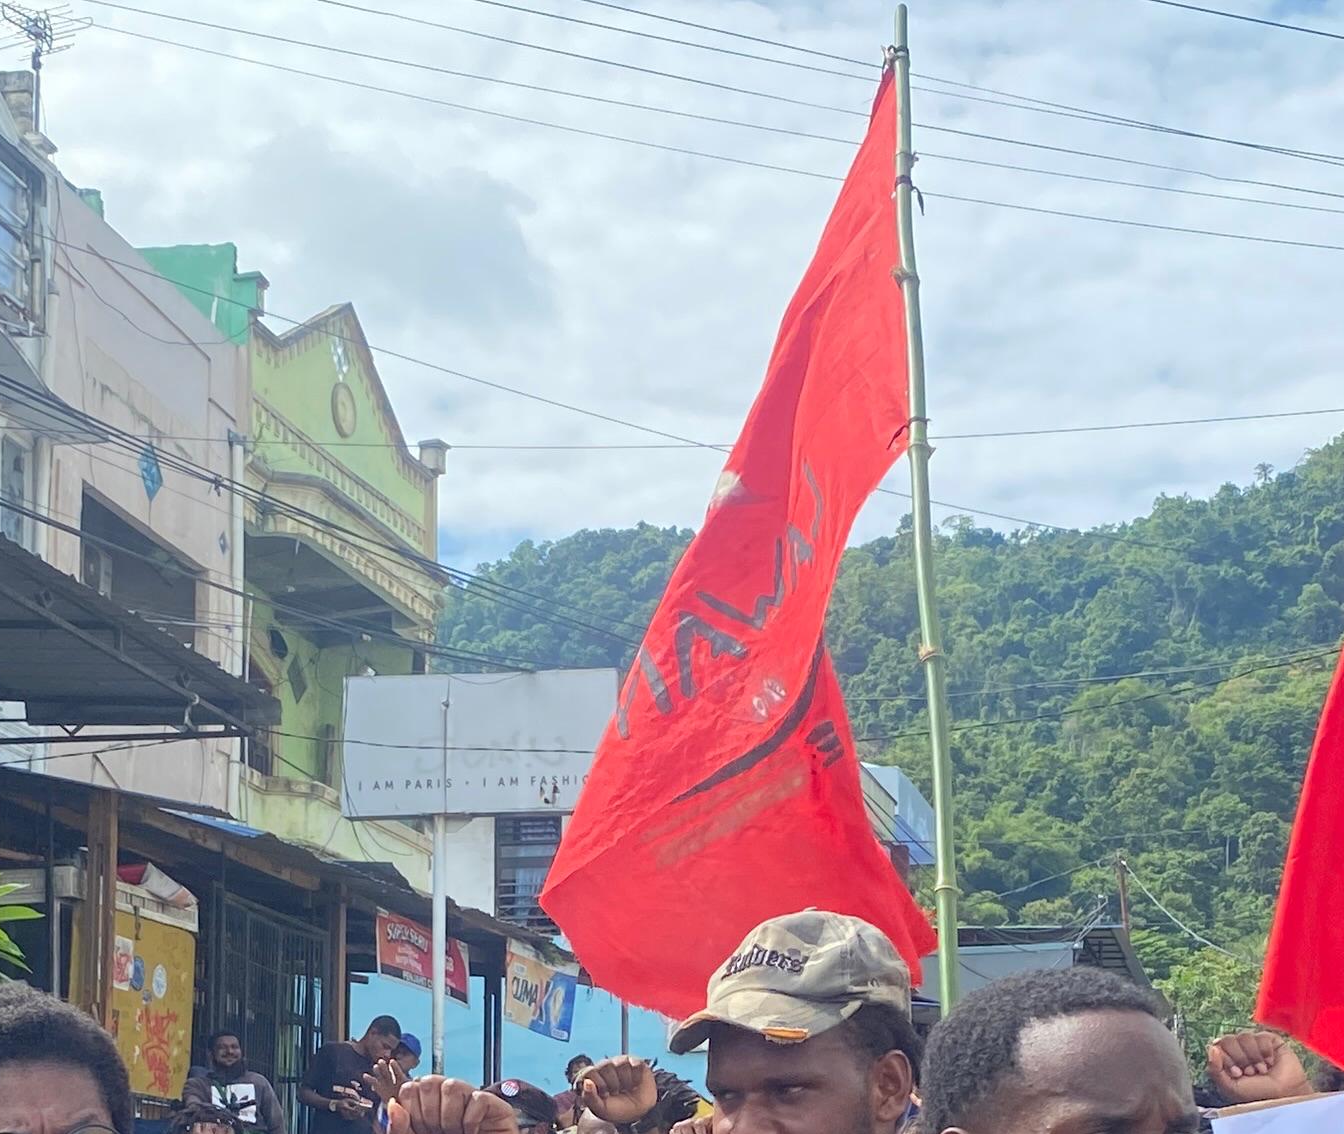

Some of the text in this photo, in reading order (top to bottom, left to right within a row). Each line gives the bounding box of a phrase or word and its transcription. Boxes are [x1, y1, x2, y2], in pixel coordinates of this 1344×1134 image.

[372, 780, 394, 791] AM
[405, 778, 453, 790] PARIS
[498, 776, 520, 787] AM
